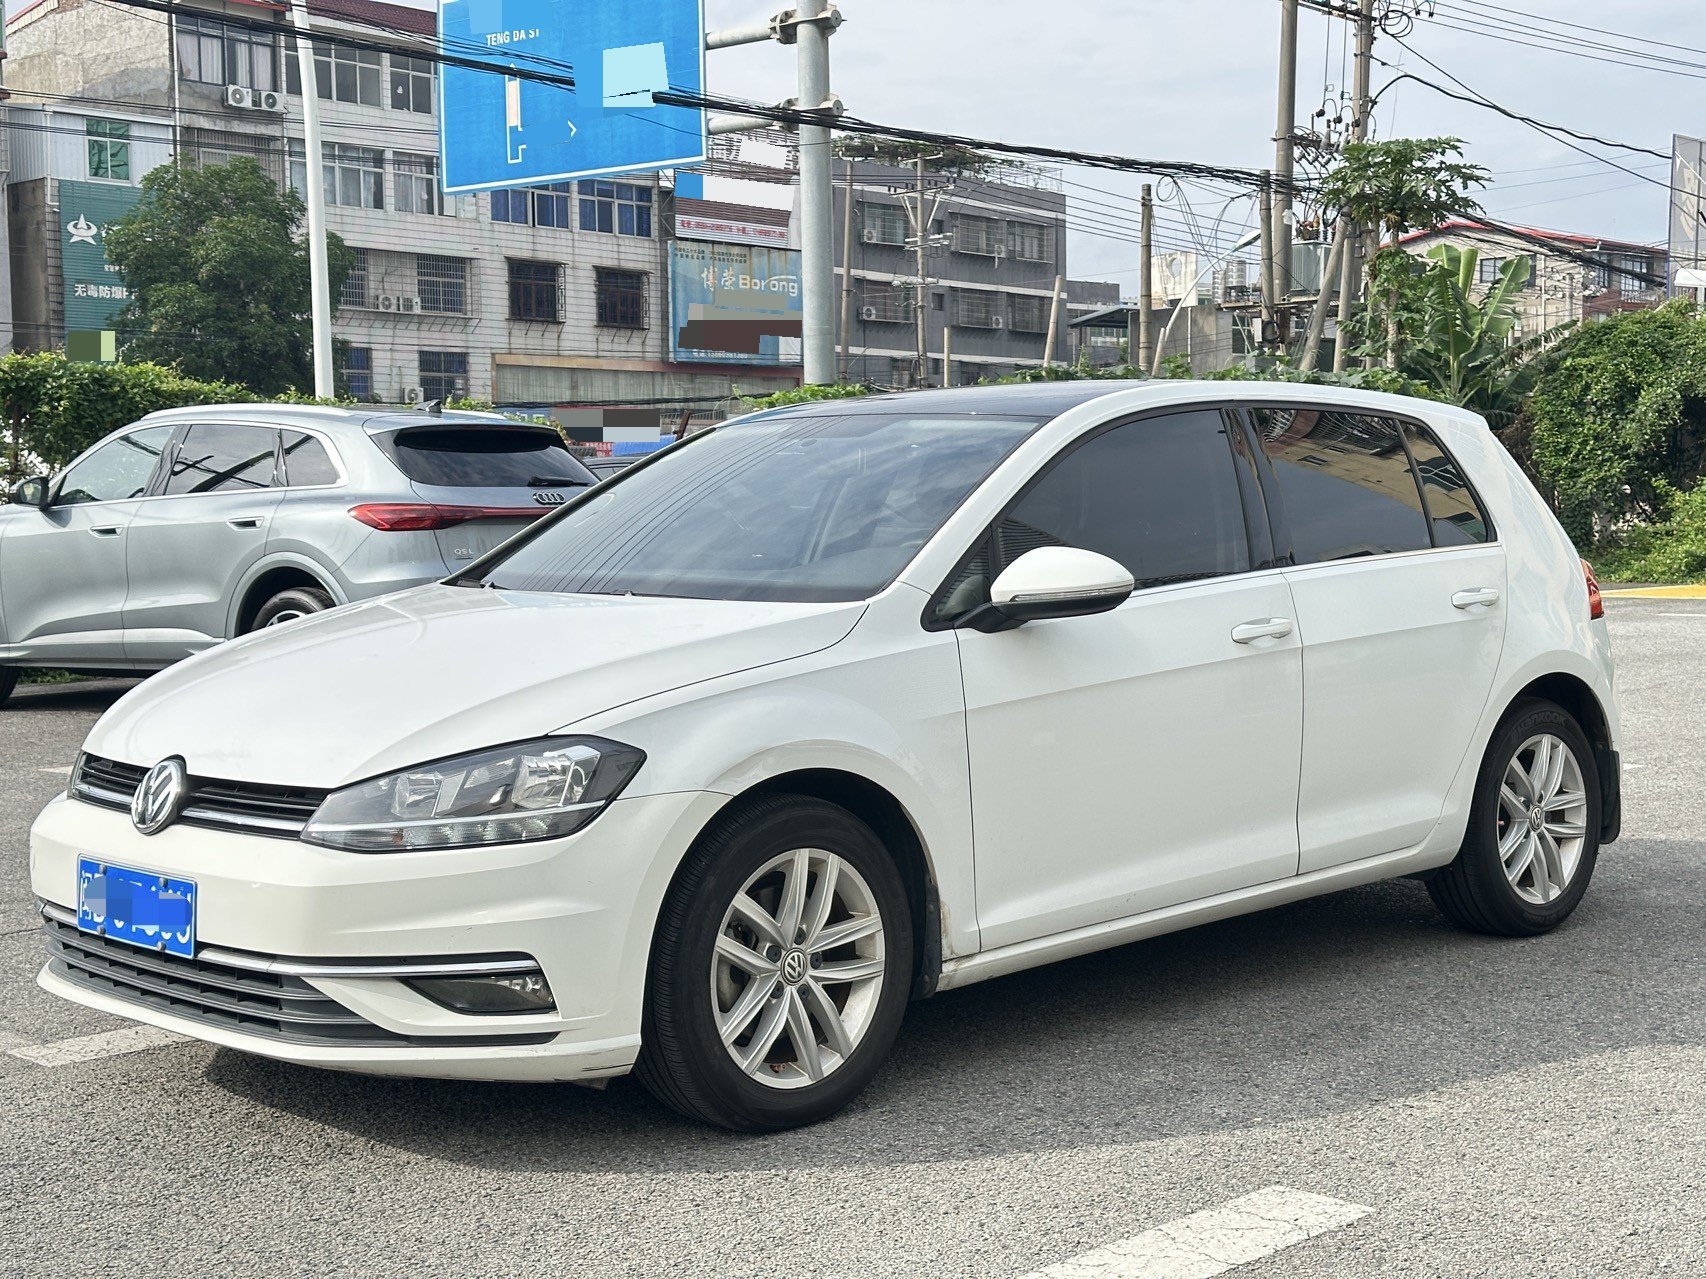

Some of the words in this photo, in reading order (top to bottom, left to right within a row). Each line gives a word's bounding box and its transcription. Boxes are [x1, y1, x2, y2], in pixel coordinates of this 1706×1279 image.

[486, 31, 510, 46] TENG
[513, 29, 526, 41] DA
[739, 274, 799, 297] Borong
